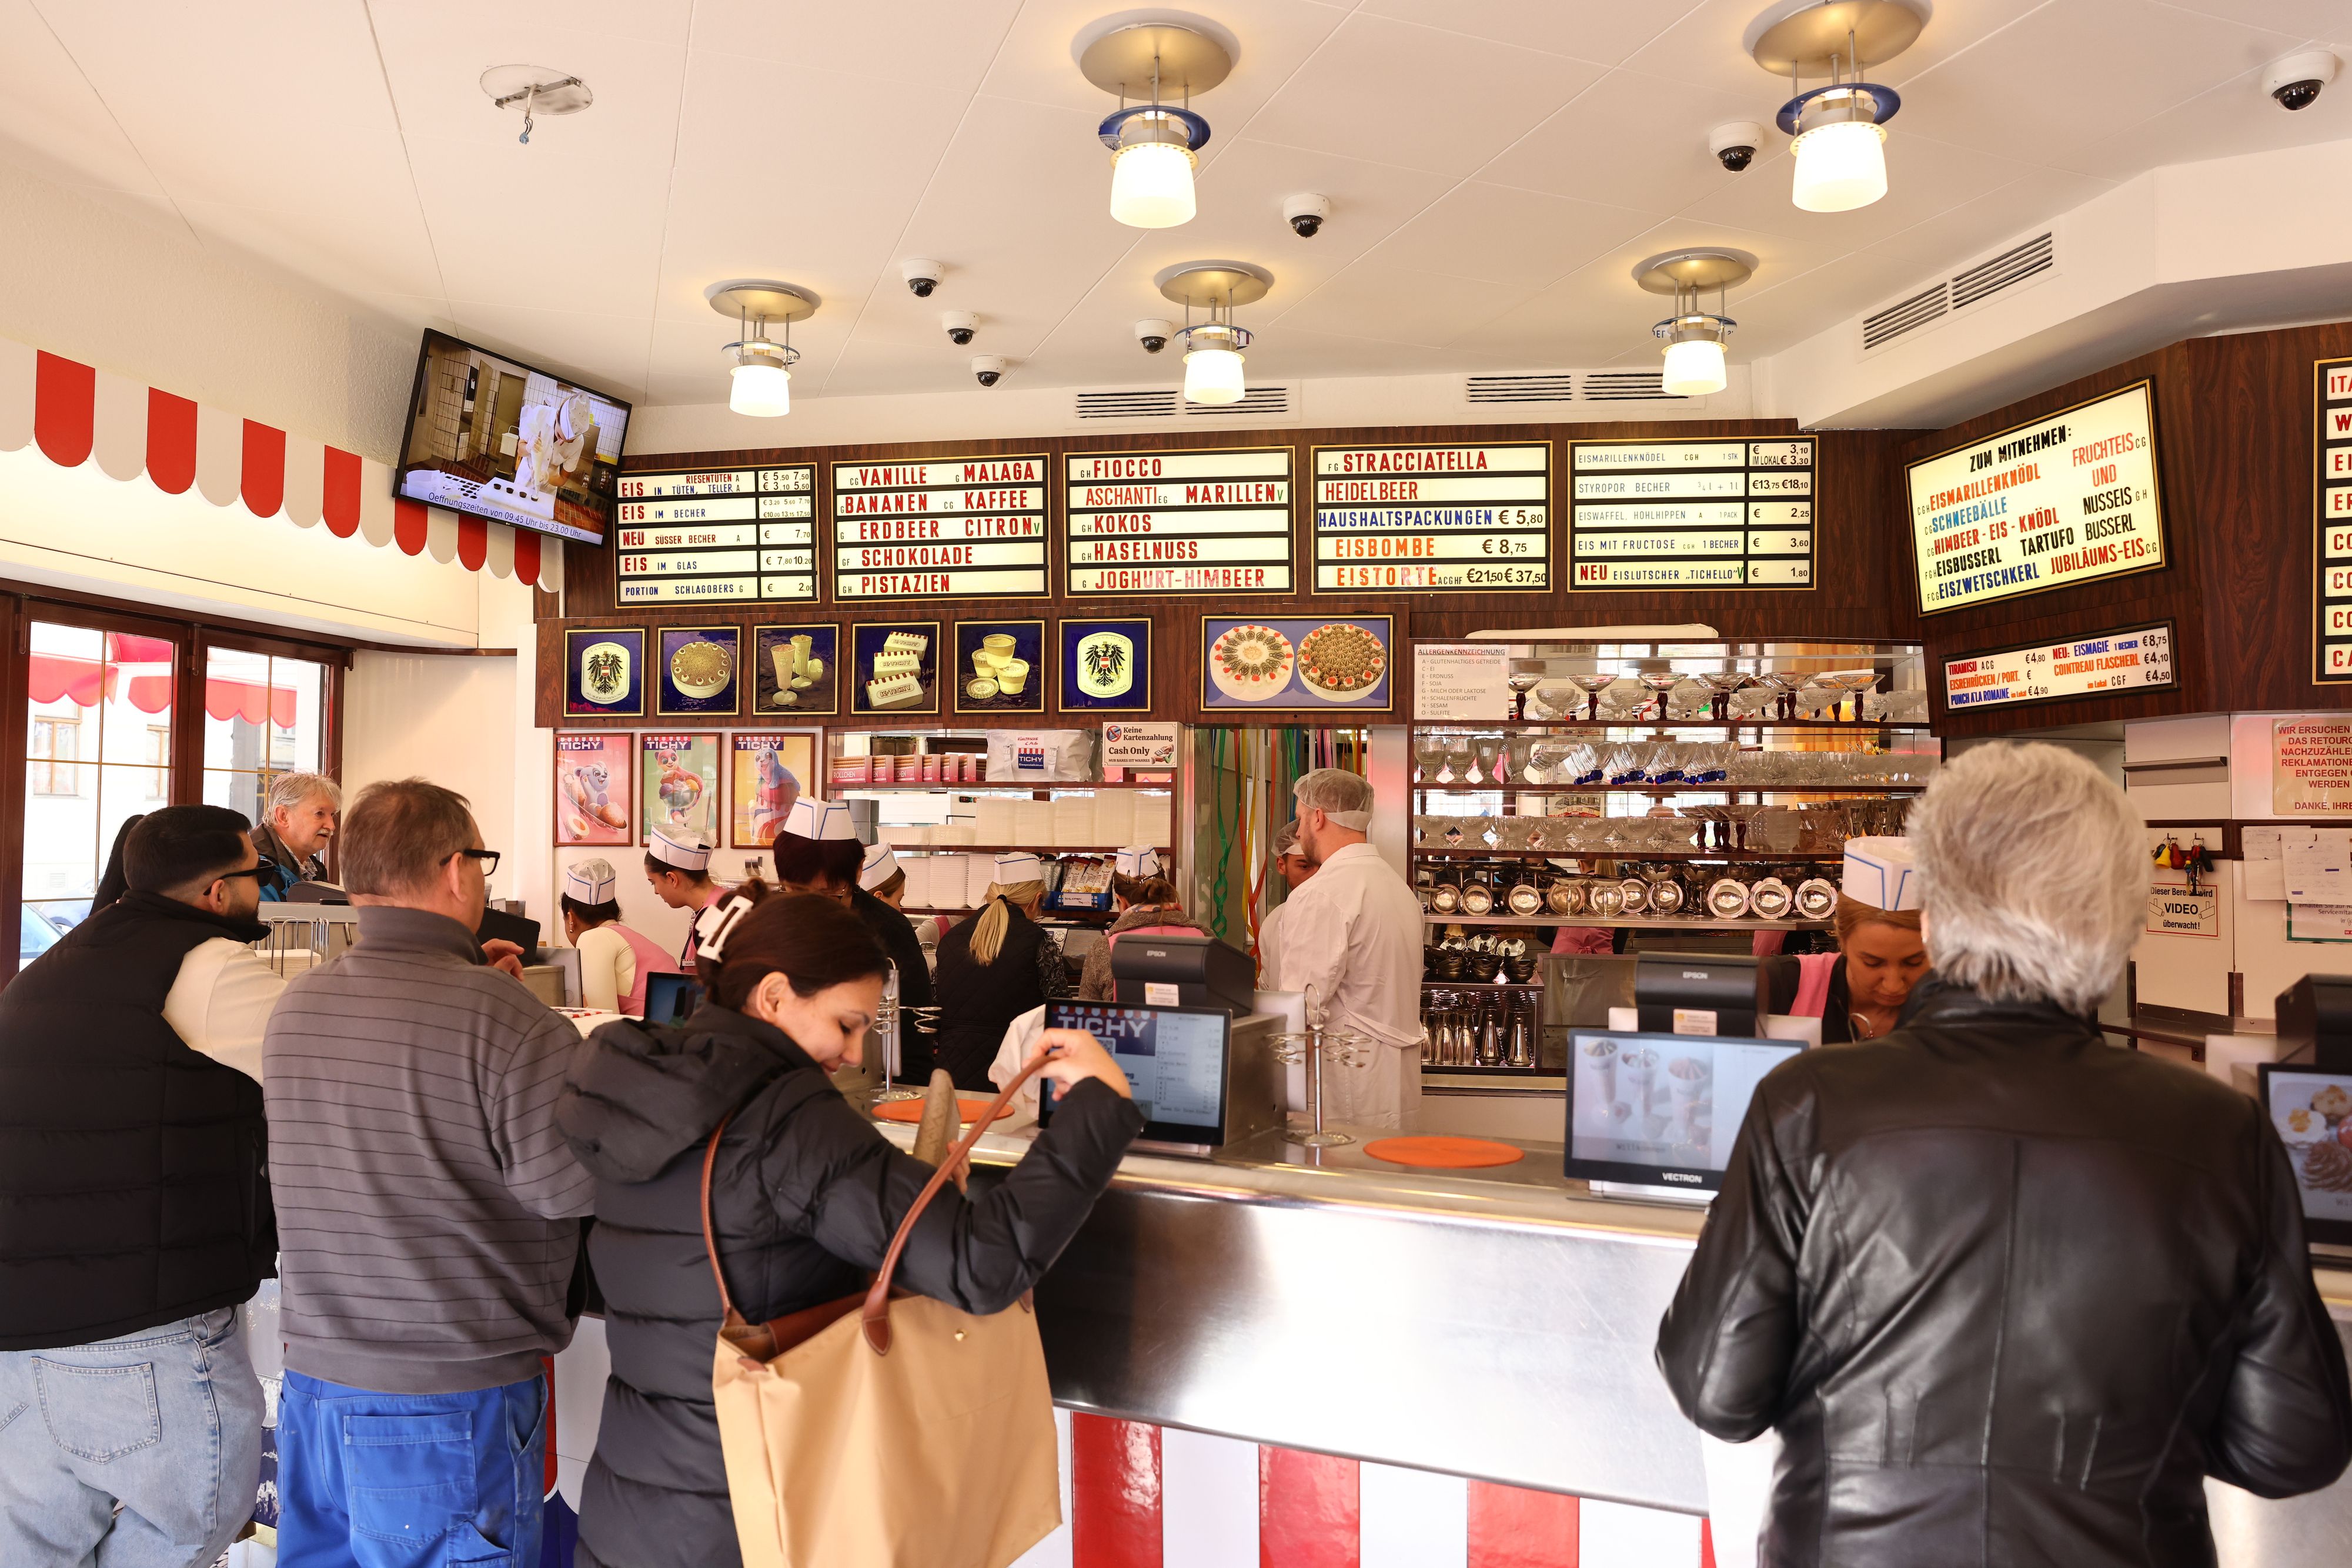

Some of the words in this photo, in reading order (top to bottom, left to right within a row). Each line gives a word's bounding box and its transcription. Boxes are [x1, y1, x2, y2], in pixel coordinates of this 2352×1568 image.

[1578, 452, 1666, 464] EISMARILLENKNÖDEL
[1790, 444, 1808, 456] 3,10
[1970, 449, 1992, 472] ZUM
[1998, 424, 2072, 463] MITNEHMEN:
[2072, 432, 2134, 467] FRUCHTEIS
[1094, 459, 1161, 478] FIOCCO
[1344, 451, 1488, 472] STRACCIATELLA
[1752, 455, 1758, 465] IM
[1760, 456, 1780, 465] LOKAL
[686, 473, 731, 484] RIESENTÜTEN
[773, 472, 789, 481] 5,50
[794, 472, 809, 480] 7,50
[859, 466, 926, 486] VANILLE
[964, 462, 1034, 482] MALAGA
[622, 482, 643, 497] EIS
[654, 487, 662, 495] IN
[672, 484, 697, 495] TÜTEN,
[708, 484, 733, 493] TELLER
[773, 482, 790, 492] 3,10
[794, 481, 809, 491] 5,50
[1085, 486, 1157, 506] ASCHANTI
[1186, 484, 1275, 503] MARILLEN
[1278, 489, 1283, 501] V
[1326, 482, 1418, 500] HEIDELBEER
[1578, 483, 1626, 493] STYROPOR
[1635, 482, 1670, 492] BECHER
[1930, 463, 2040, 511] EISMARILLENKNÖDL
[2092, 464, 2117, 487] UND
[846, 493, 927, 514] BANANEN
[965, 490, 1027, 510] KAFFEE
[1932, 496, 2007, 533] SCHNEEBÄLLE
[2083, 486, 2132, 516] NUSSEIS
[428, 492, 489, 516] Oeffnungszeiten
[490, 509, 503, 519] von
[505, 511, 524, 523] 09.45
[526, 517, 538, 528] Uhr
[539, 521, 549, 531] bis
[550, 523, 569, 534] 23.00
[570, 529, 582, 539] Uhr
[622, 506, 644, 520] EIS
[656, 510, 663, 519] IM
[674, 509, 706, 518] BECHER
[1318, 509, 1492, 527] HAUSHALTSPACKUNGEN
[1516, 510, 1543, 526] 5,80
[1633, 510, 1686, 520] HOHLHIPPEN
[1791, 507, 1809, 519] 2,25
[860, 520, 939, 540] ERDBEER
[965, 517, 1031, 537] CITRON
[1034, 522, 1040, 534] V
[1095, 514, 1151, 533] KOKOS
[623, 531, 644, 546] NEU
[656, 535, 682, 544] SÜSSER
[689, 534, 716, 543] BECHER
[795, 530, 810, 538] 7,70
[1336, 537, 1434, 557] EISBOMBE
[1499, 539, 1527, 556] 8,75
[1578, 540, 1595, 550] EIS
[1600, 540, 1617, 550] MIT
[1623, 539, 1675, 550] FRUCTOSE
[1709, 540, 1739, 549] BECHER
[1790, 538, 1809, 549] 3,60
[1936, 547, 2002, 577] EISBUSSERL
[2020, 527, 2074, 556] TARTUFO
[2085, 513, 2136, 541] BUSSERL
[862, 546, 973, 567] SCHOKOLADE
[1095, 541, 1198, 561] HASELNUSS
[624, 557, 647, 571] EIS
[657, 562, 666, 570] IM
[677, 561, 697, 570] GLAS
[777, 557, 792, 565] 7,80
[794, 556, 812, 564] 10,20
[1580, 564, 1607, 580] NEU
[1613, 570, 1679, 580] EISLUTSCHER
[1790, 567, 1808, 578] 1,80
[1939, 562, 2040, 600] EISZWETSCHKERL
[2050, 537, 2144, 575] JUBILÄUMS-EIS
[862, 574, 950, 594] PISTAZIEN
[1095, 569, 1264, 589] JOGHURT-HIMBEER
[1338, 566, 1436, 586] EISTORTE
[626, 587, 659, 596] PORTION
[675, 584, 734, 594] SCHLAGOBERS
[1948, 660, 1977, 676] TIRAMISU
[2053, 647, 2070, 660] NEU:
[2074, 640, 2110, 657] EISMAGIE
[1950, 673, 1996, 690] EISREHRÜCKEN
[2002, 670, 2020, 683] PORT.
[2054, 660, 2094, 677] COINTREAU
[2096, 653, 2140, 670] FLASCHERL
[1950, 692, 1970, 706] PUNCH
[1983, 688, 2010, 701] ROMAINE
[2278, 726, 2296, 734] WIR
[2298, 726, 2350, 734] ERSUCHEN
[560, 740, 600, 750] TICHY
[647, 741, 688, 750] TICHY
[738, 741, 781, 750] TICHY
[2288, 737, 2307, 745] DAS
[1108, 746, 1128, 754] Cash
[1130, 746, 1150, 756] Only
[2296, 769, 2347, 777] ENTGEGEN
[2294, 802, 2330, 811] DANKE,
[2150, 887, 2170, 895] Dieser
[2164, 902, 2199, 915] VIDEO
[2163, 920, 2200, 930] überwacht!
[1146, 950, 1167, 958] EPSON
[1682, 971, 1708, 979] EPSON
[1058, 1015, 1148, 1038] TICHY
[1662, 1172, 1703, 1183] VECTRON
